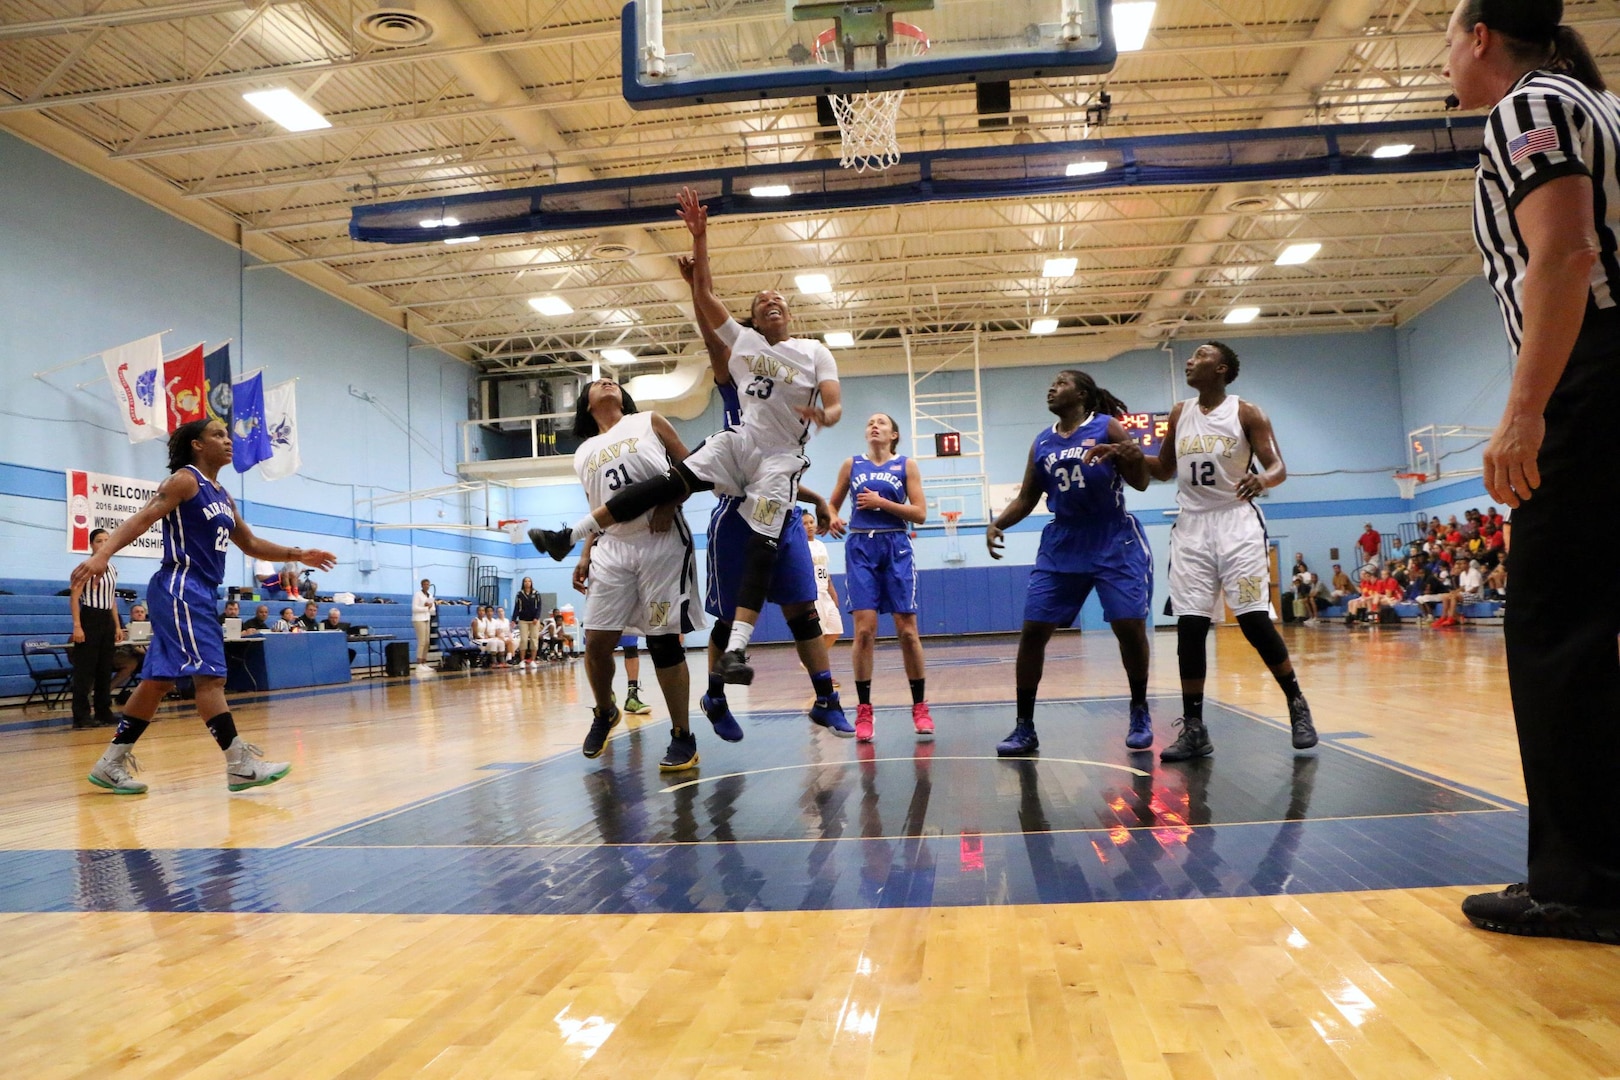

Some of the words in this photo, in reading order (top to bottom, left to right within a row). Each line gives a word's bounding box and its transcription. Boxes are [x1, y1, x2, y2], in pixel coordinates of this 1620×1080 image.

[745, 375, 774, 400] 23
[944, 435, 959, 452] 17
[1143, 434, 1151, 446] 2
[1178, 434, 1236, 459] NAVY
[587, 438, 639, 475] NAVY
[605, 463, 633, 490] 31
[852, 473, 867, 490] AIR
[870, 472, 903, 490] FORCE
[1055, 464, 1086, 492] 34
[1190, 461, 1216, 486] 12
[95, 502, 112, 511] 2016
[113, 505, 137, 514] ARMED
[202, 502, 221, 520] AIR
[753, 497, 781, 526] N
[214, 526, 230, 552] 22
[817, 568, 828, 579] 20
[1237, 575, 1262, 604] N
[650, 602, 670, 626] N
